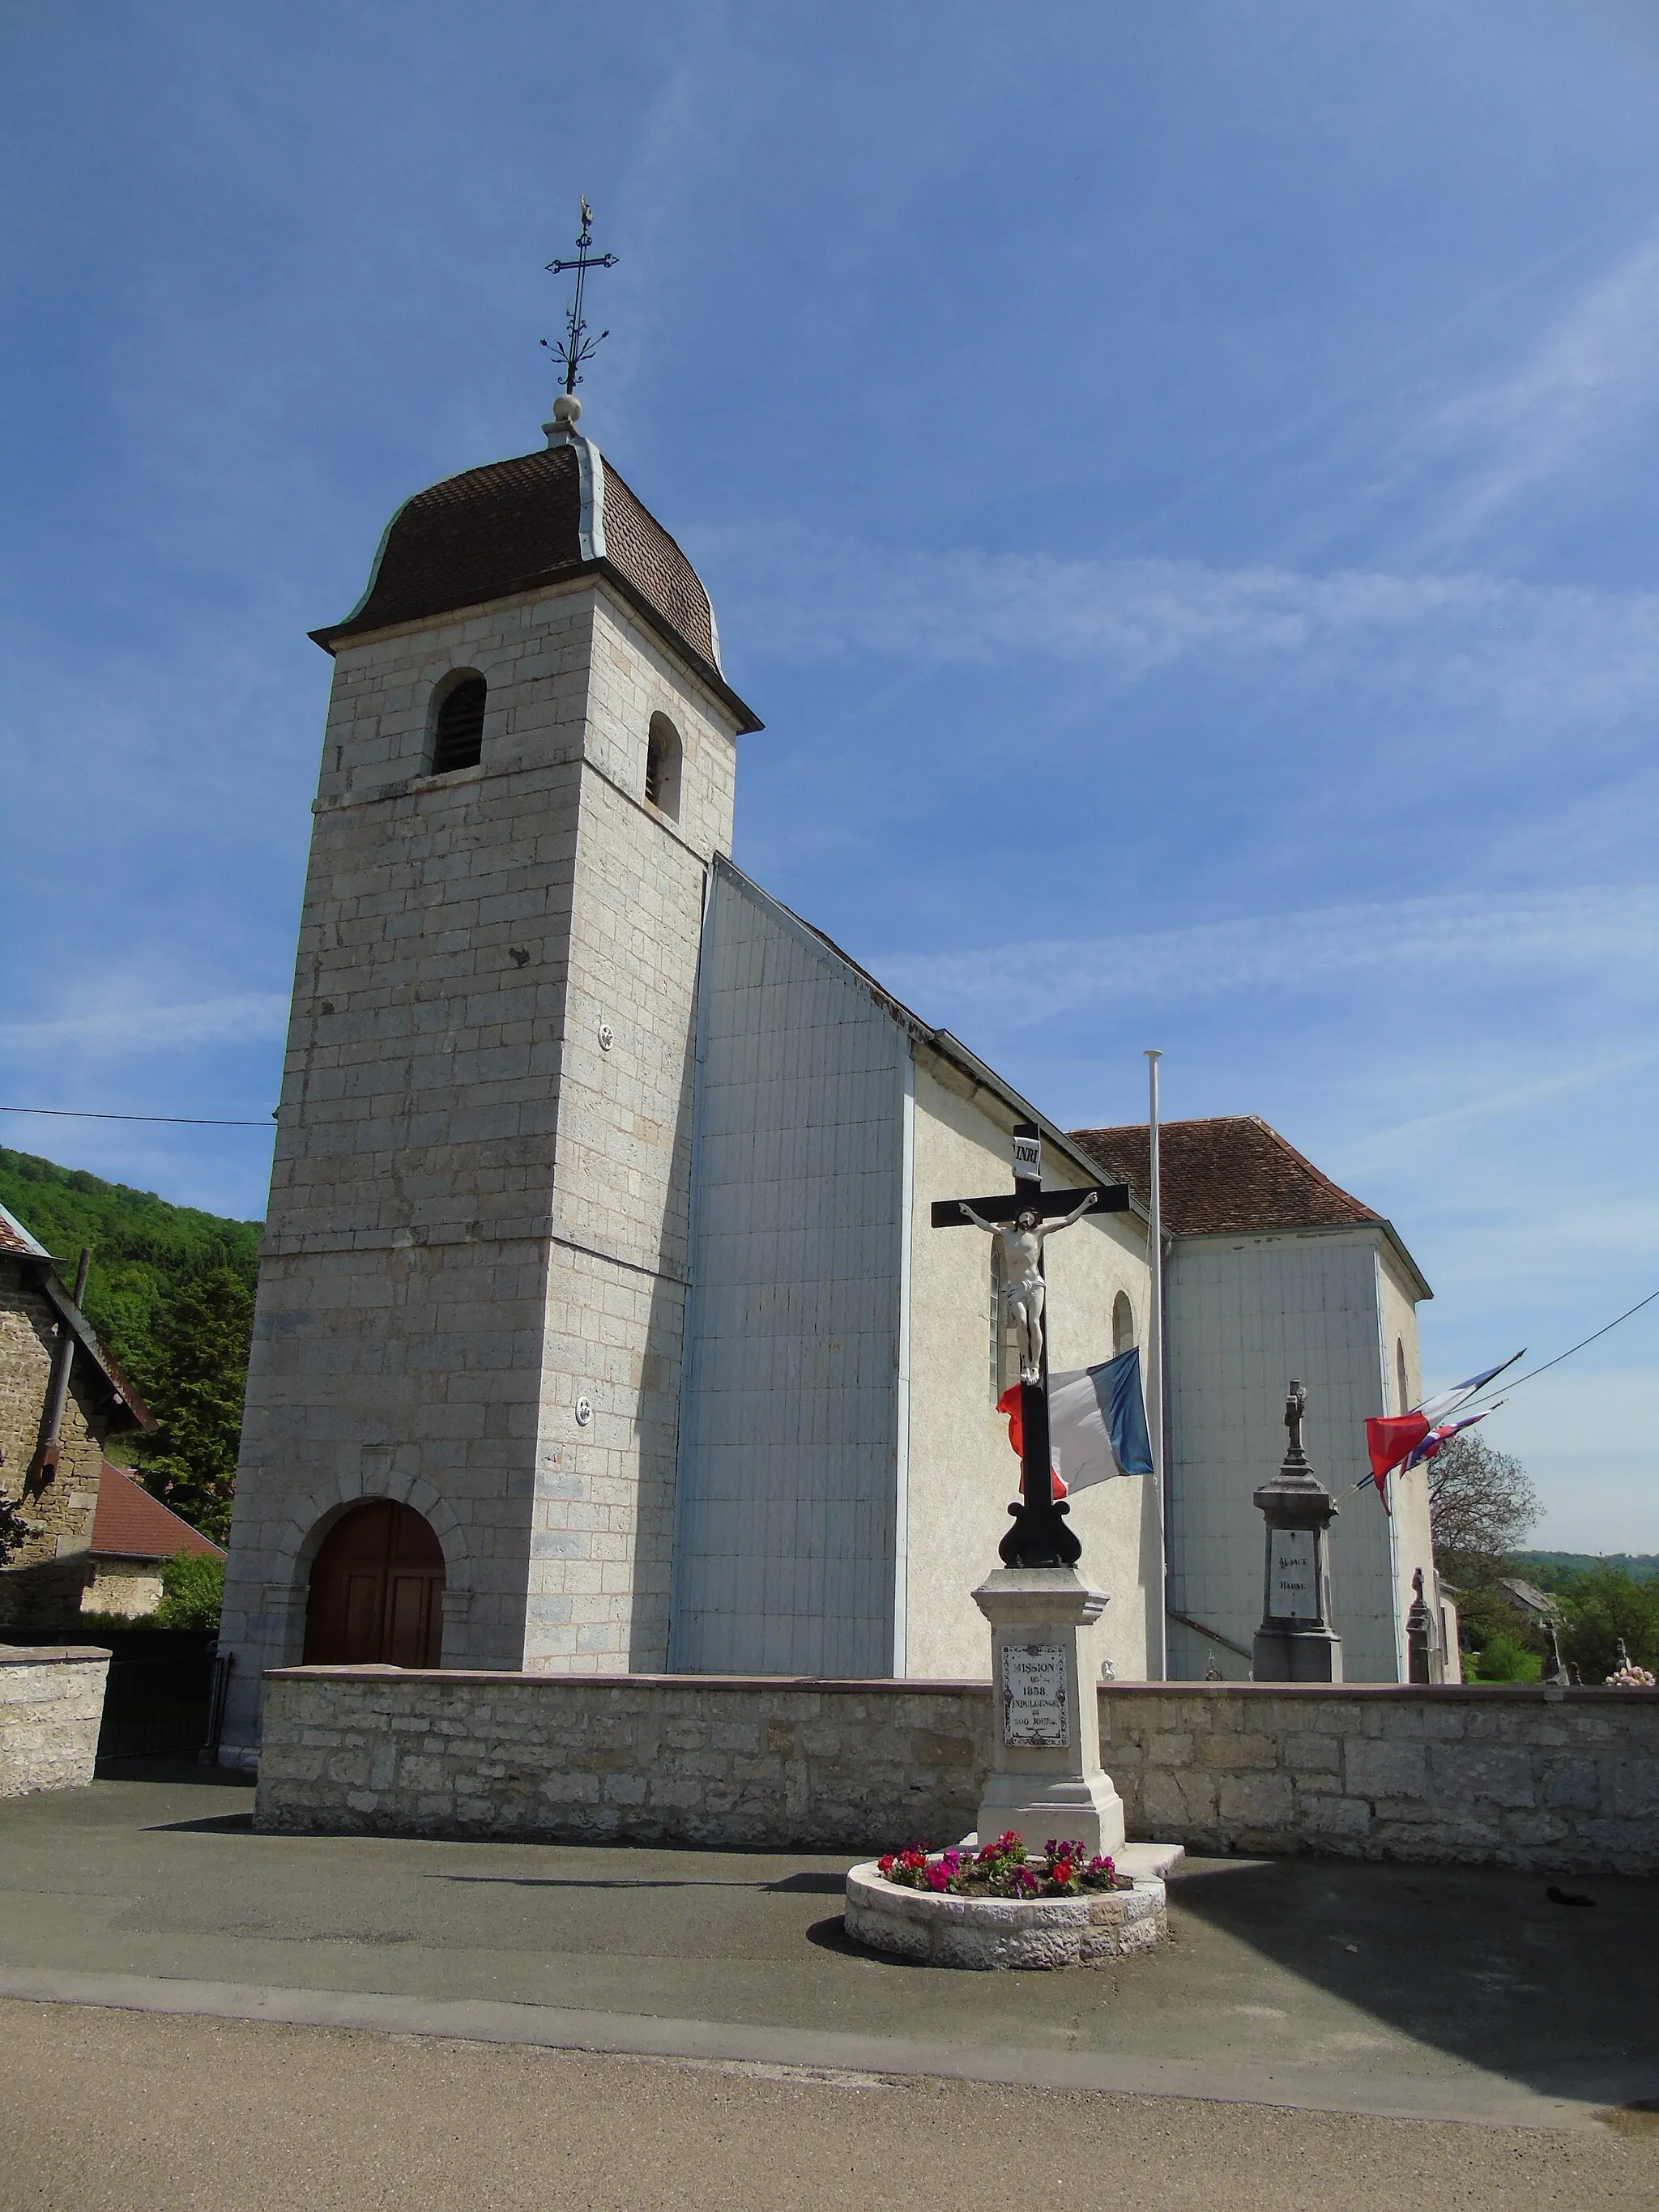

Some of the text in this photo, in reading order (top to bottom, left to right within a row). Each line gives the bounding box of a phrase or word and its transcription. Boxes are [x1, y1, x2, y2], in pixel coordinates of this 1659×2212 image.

[1015, 1146, 1038, 1163] INRI
[1279, 1557, 1308, 1567] ALSACE
[1280, 1581, 1306, 1590] MARNE
[1013, 1663, 1054, 1673] MISSION
